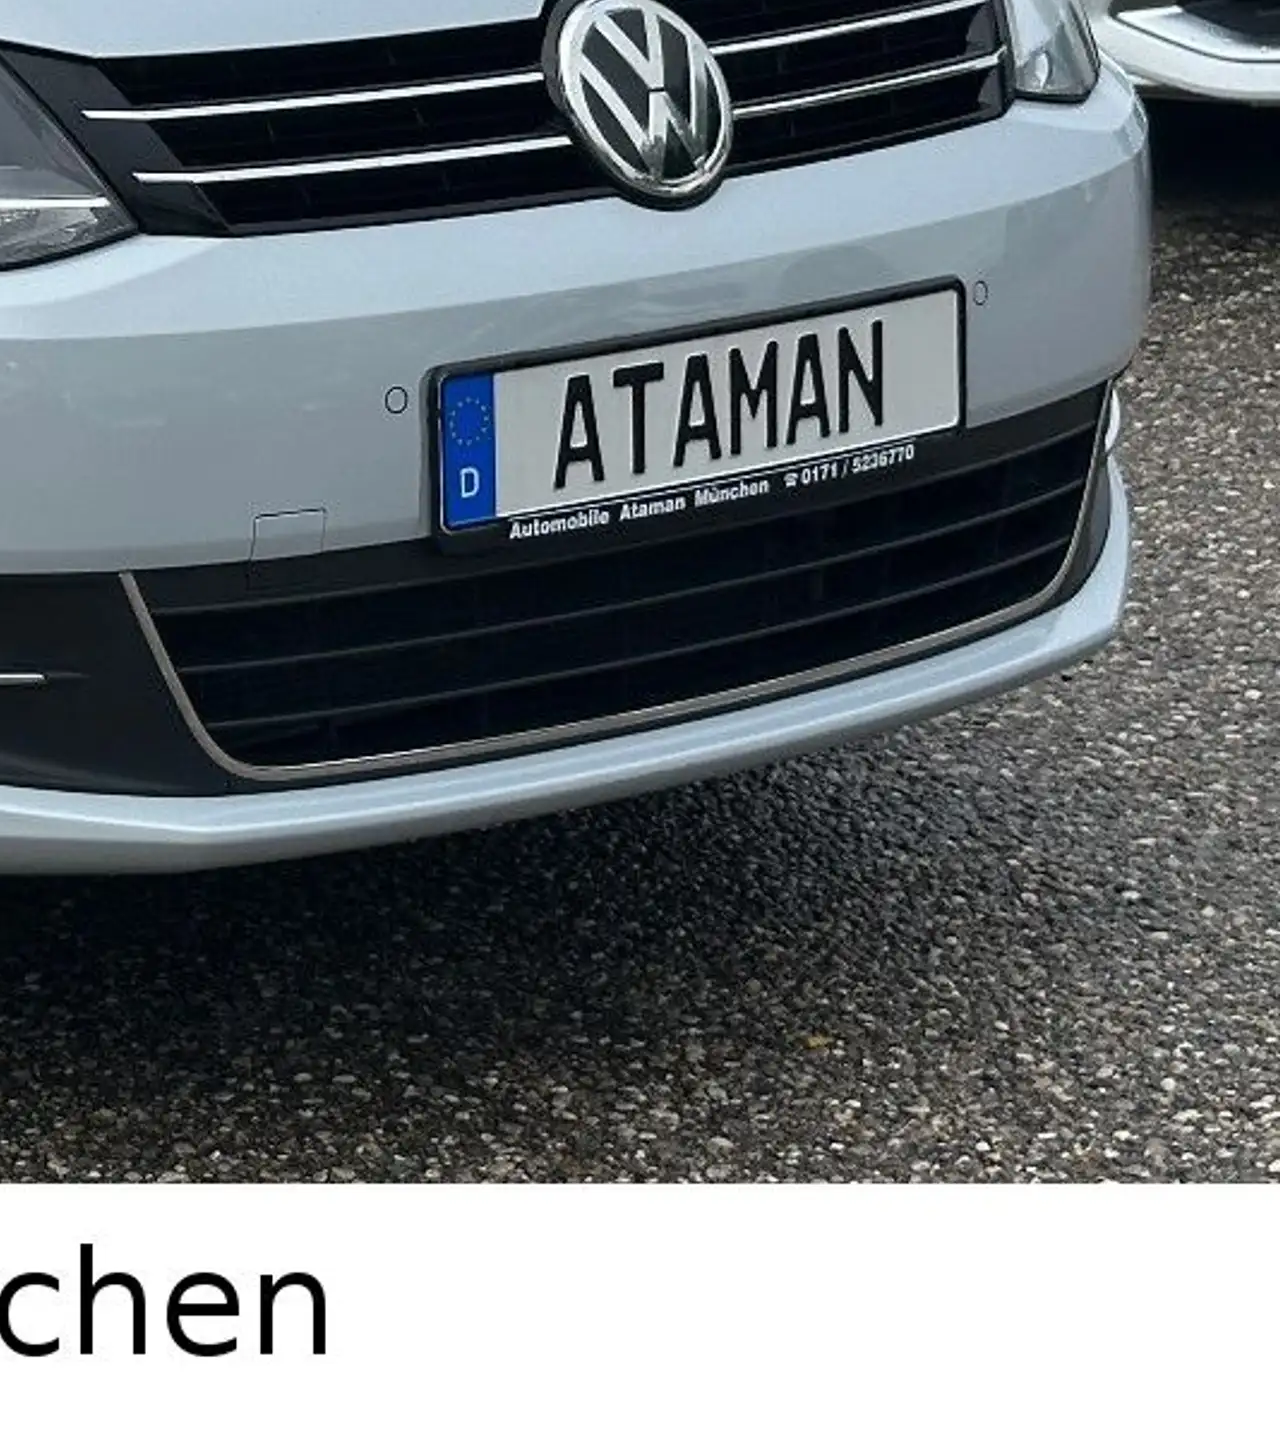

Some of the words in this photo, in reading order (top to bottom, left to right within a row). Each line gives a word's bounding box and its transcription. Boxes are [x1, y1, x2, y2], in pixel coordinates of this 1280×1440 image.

[553, 319, 884, 489] ATAMAN
[460, 465, 480, 498] D
[509, 509, 610, 540] Automobile
[618, 494, 687, 522] Ataman
[694, 478, 770, 508] München
[801, 461, 838, 485] 0171
